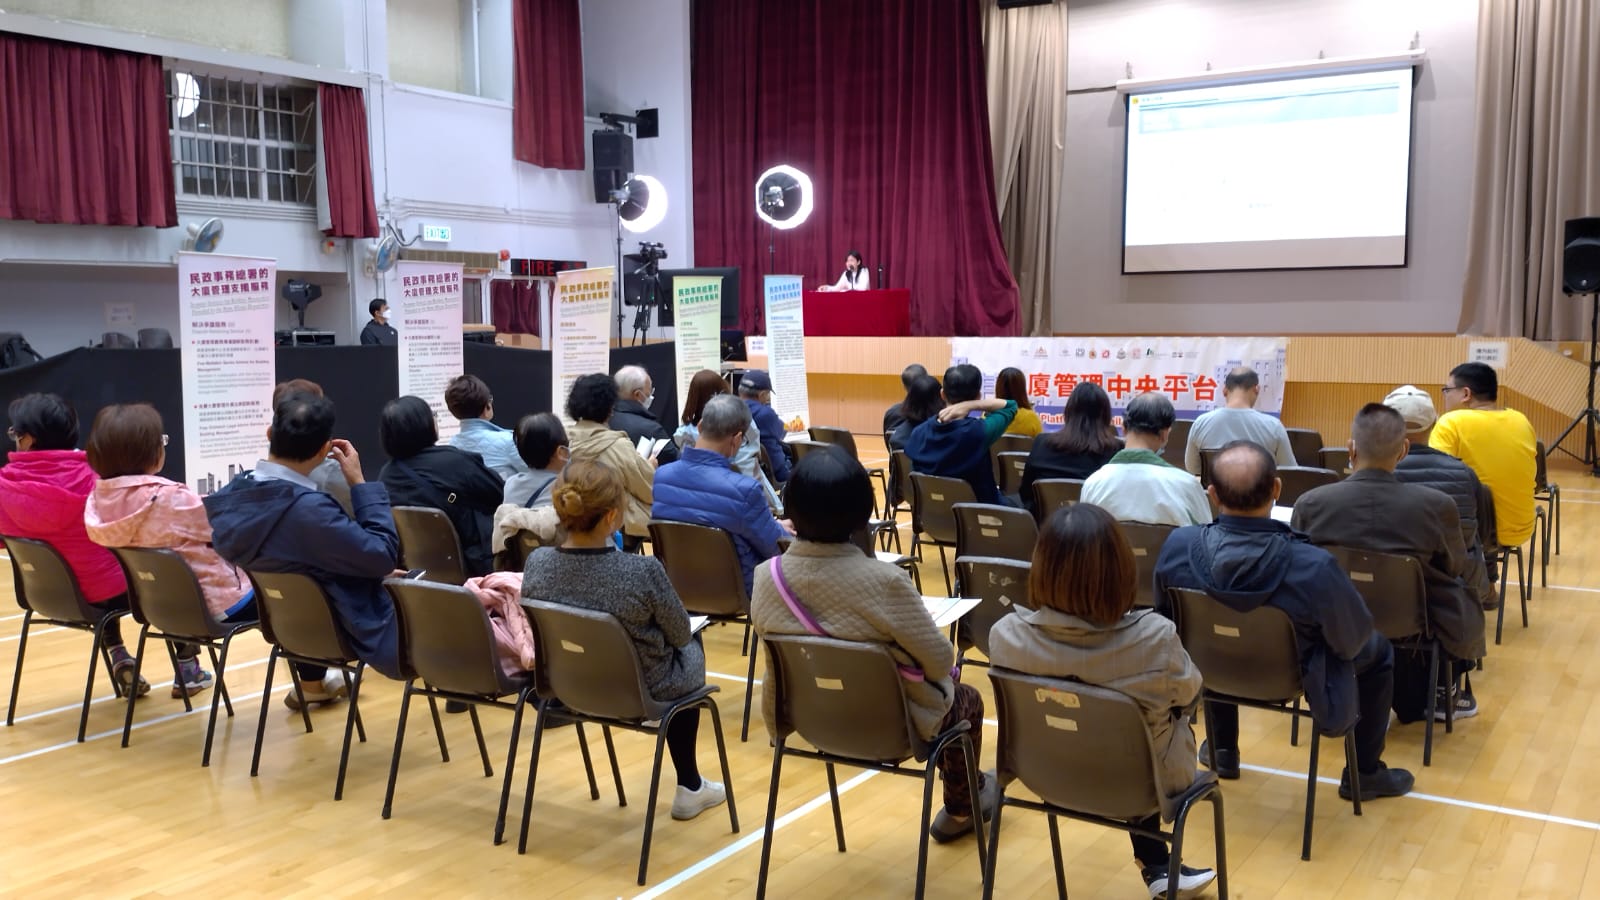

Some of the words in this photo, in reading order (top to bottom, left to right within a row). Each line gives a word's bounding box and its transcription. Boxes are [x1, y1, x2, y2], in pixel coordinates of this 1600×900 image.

[521, 260, 554, 275] FIRE
[190, 268, 269, 285] 民政事務總署的
[403, 271, 459, 287] 民政事務總署的
[191, 281, 269, 297] 大廈管理支援服務
[1040, 413, 1064, 424] Platf
